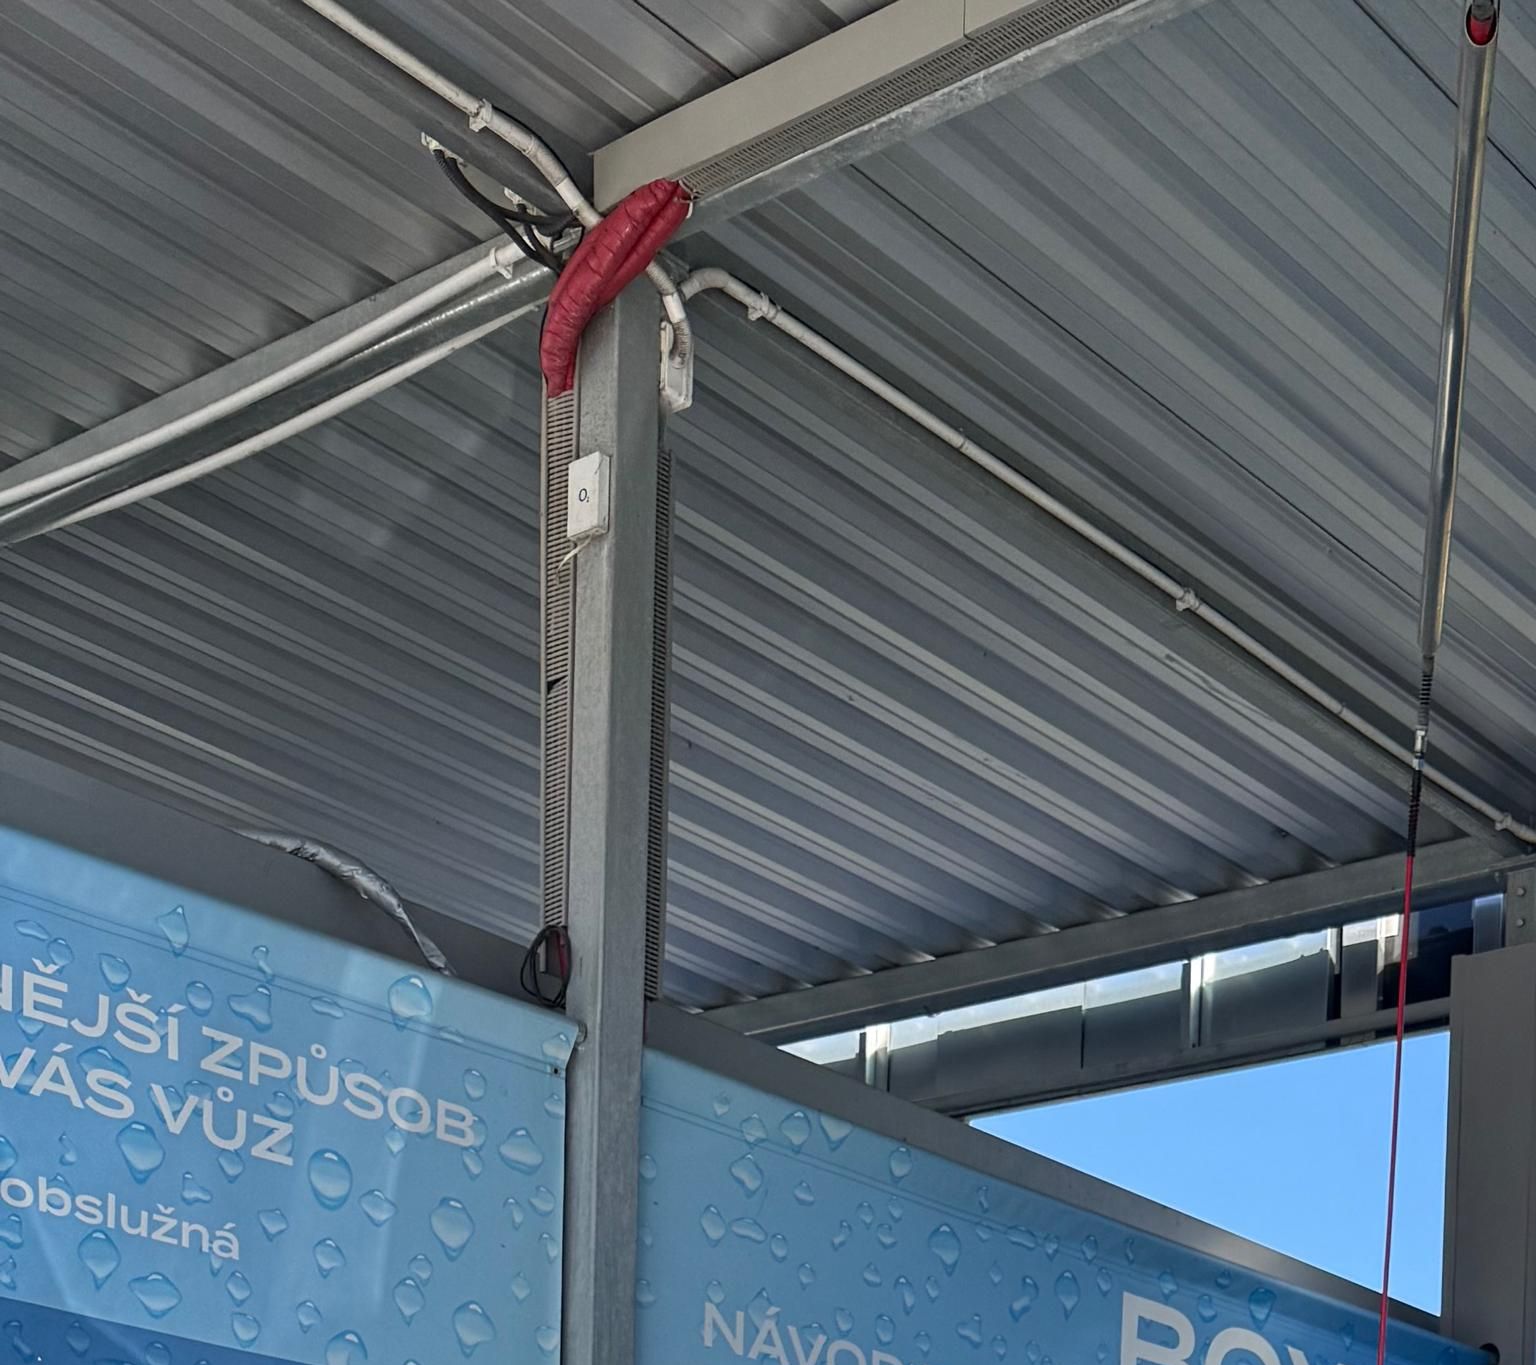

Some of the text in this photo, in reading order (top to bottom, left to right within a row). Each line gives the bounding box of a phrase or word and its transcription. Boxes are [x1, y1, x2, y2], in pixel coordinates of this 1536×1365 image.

[0, 957, 477, 1148] ĚJŠÍ ZPŮSOB
[0, 1042, 295, 1167] VÁS VŮZ
[0, 1176, 240, 1261] obslužná
